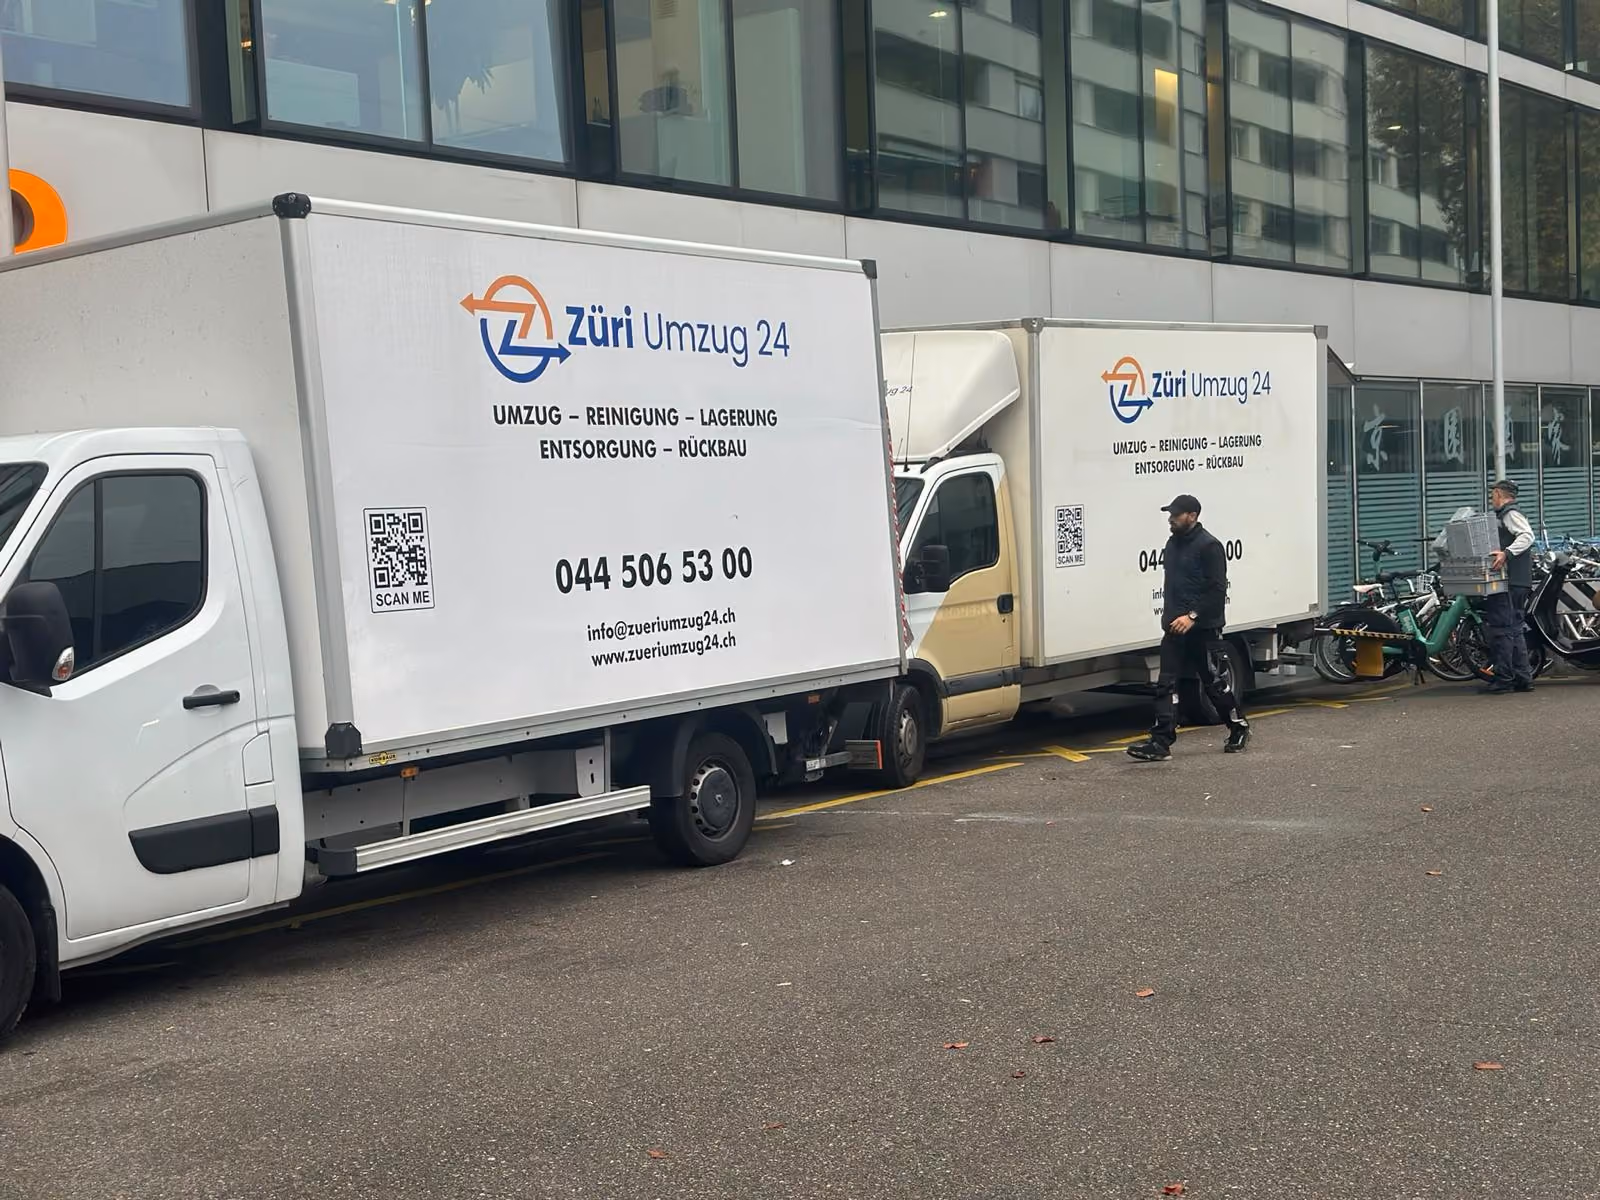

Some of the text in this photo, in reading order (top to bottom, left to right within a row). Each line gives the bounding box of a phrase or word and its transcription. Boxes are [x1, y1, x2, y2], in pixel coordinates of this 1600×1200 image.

[565, 305, 789, 367] Züri Umzug 24
[1152, 370, 1271, 404] Züri Umzug 24
[493, 405, 561, 425] UMZUG
[586, 407, 678, 426] REINIGUNG
[700, 409, 777, 426] LAGERUNG
[540, 440, 656, 459] ENTSORGUNG
[679, 436, 746, 457] RÜCKBAU
[1114, 441, 1147, 455] UMZUG
[1160, 438, 1207, 451] REINIGUNG
[1219, 435, 1261, 448] LAGERUNG
[1135, 459, 1194, 474] ENTSORGUNG
[1207, 455, 1243, 469] RÜCKBAU
[1058, 554, 1083, 565] SCAN ME
[1226, 539, 1242, 561] 00
[556, 547, 752, 594] 044 506 53 00
[376, 591, 430, 606] SCAN ME
[587, 608, 736, 642] info@zueriumzug24.ch
[592, 632, 736, 667] www.zueriumzug24.ch
